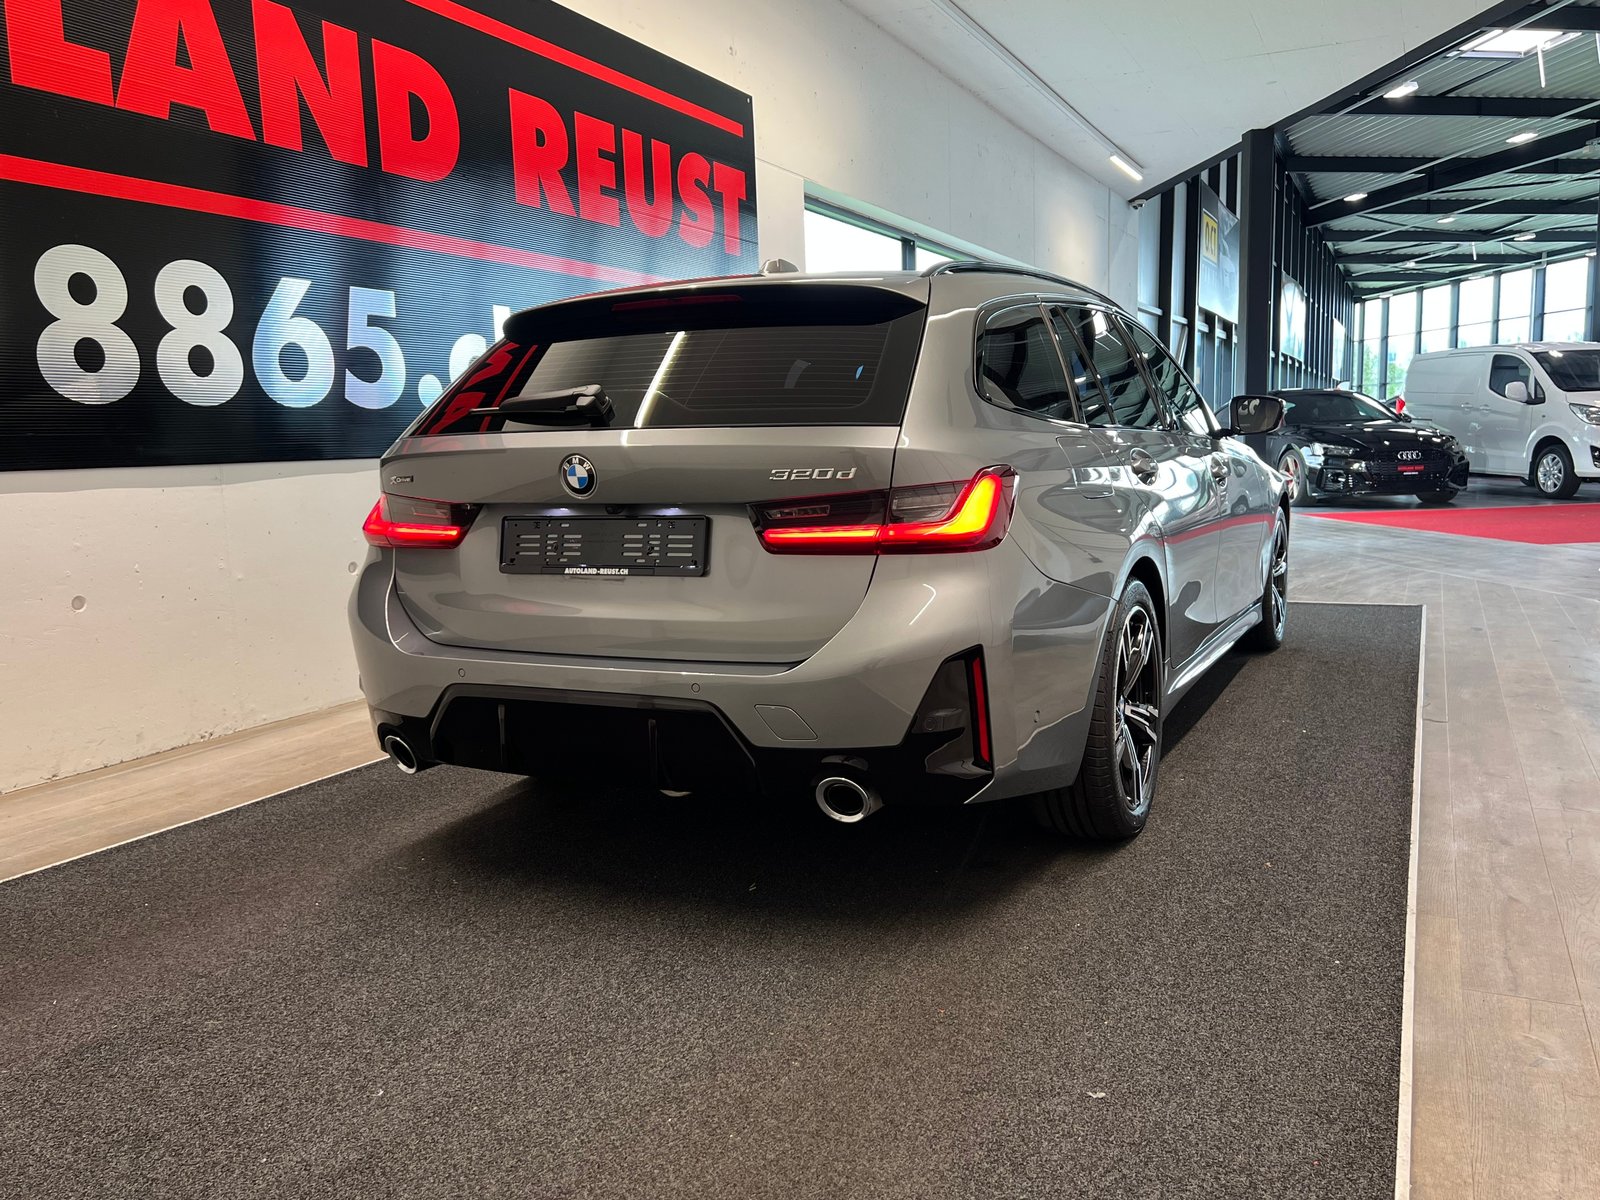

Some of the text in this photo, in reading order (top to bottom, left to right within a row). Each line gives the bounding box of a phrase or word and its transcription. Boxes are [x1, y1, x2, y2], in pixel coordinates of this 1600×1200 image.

[4, 0, 746, 256] LAND REUST
[34, 244, 511, 408] 8865.c
[563, 457, 591, 470] BMW
[769, 467, 857, 480] 320d
[564, 567, 629, 575] AUTOLAND-REUST.CH
